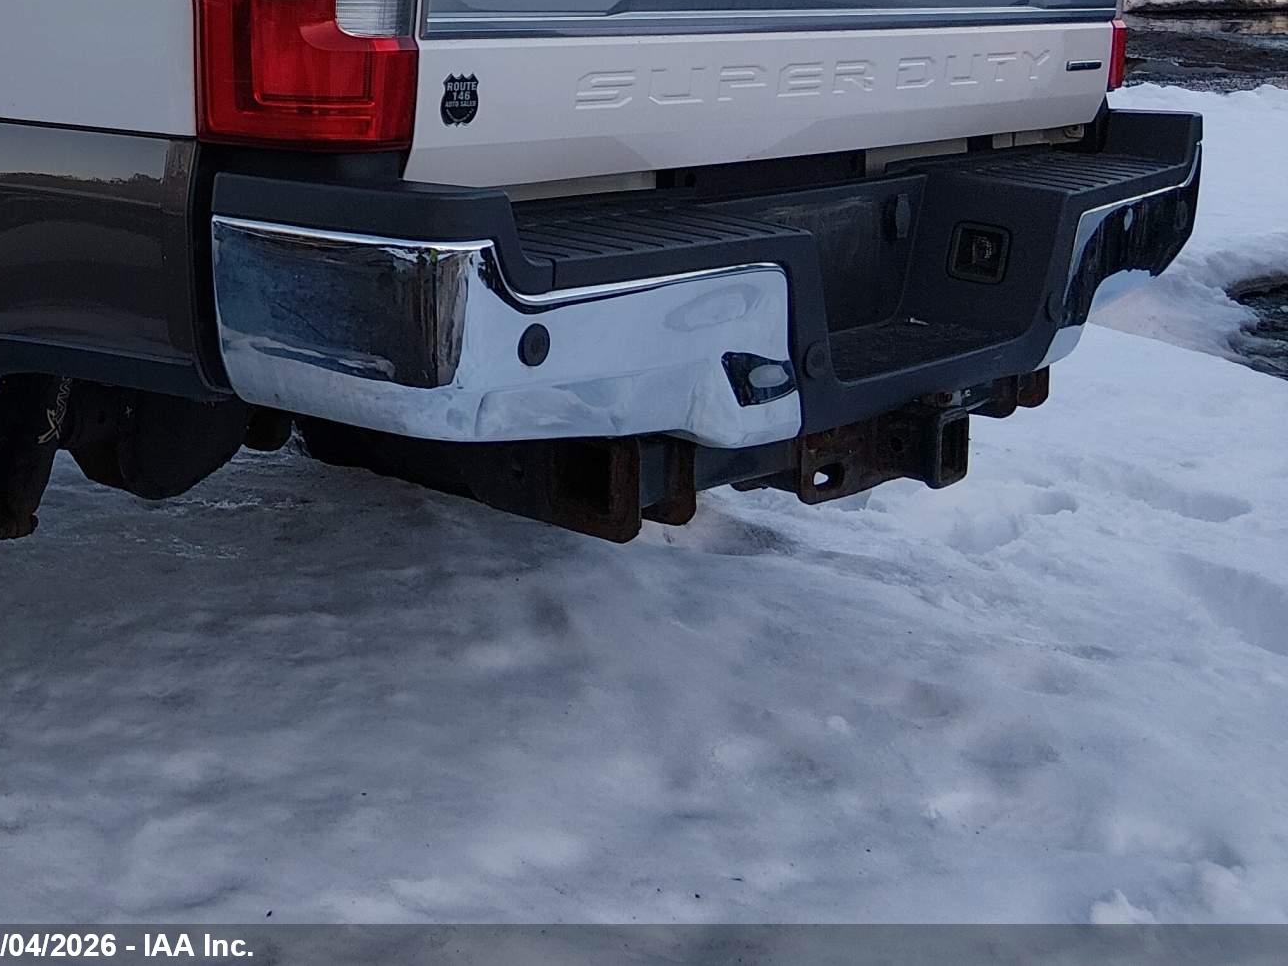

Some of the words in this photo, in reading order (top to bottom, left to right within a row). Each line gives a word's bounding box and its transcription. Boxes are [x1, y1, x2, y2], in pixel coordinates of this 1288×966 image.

[574, 59, 876, 110] SUPER
[896, 49, 1051, 90] DUTY
[447, 81, 477, 91] ROUTE
[452, 91, 471, 101] 146
